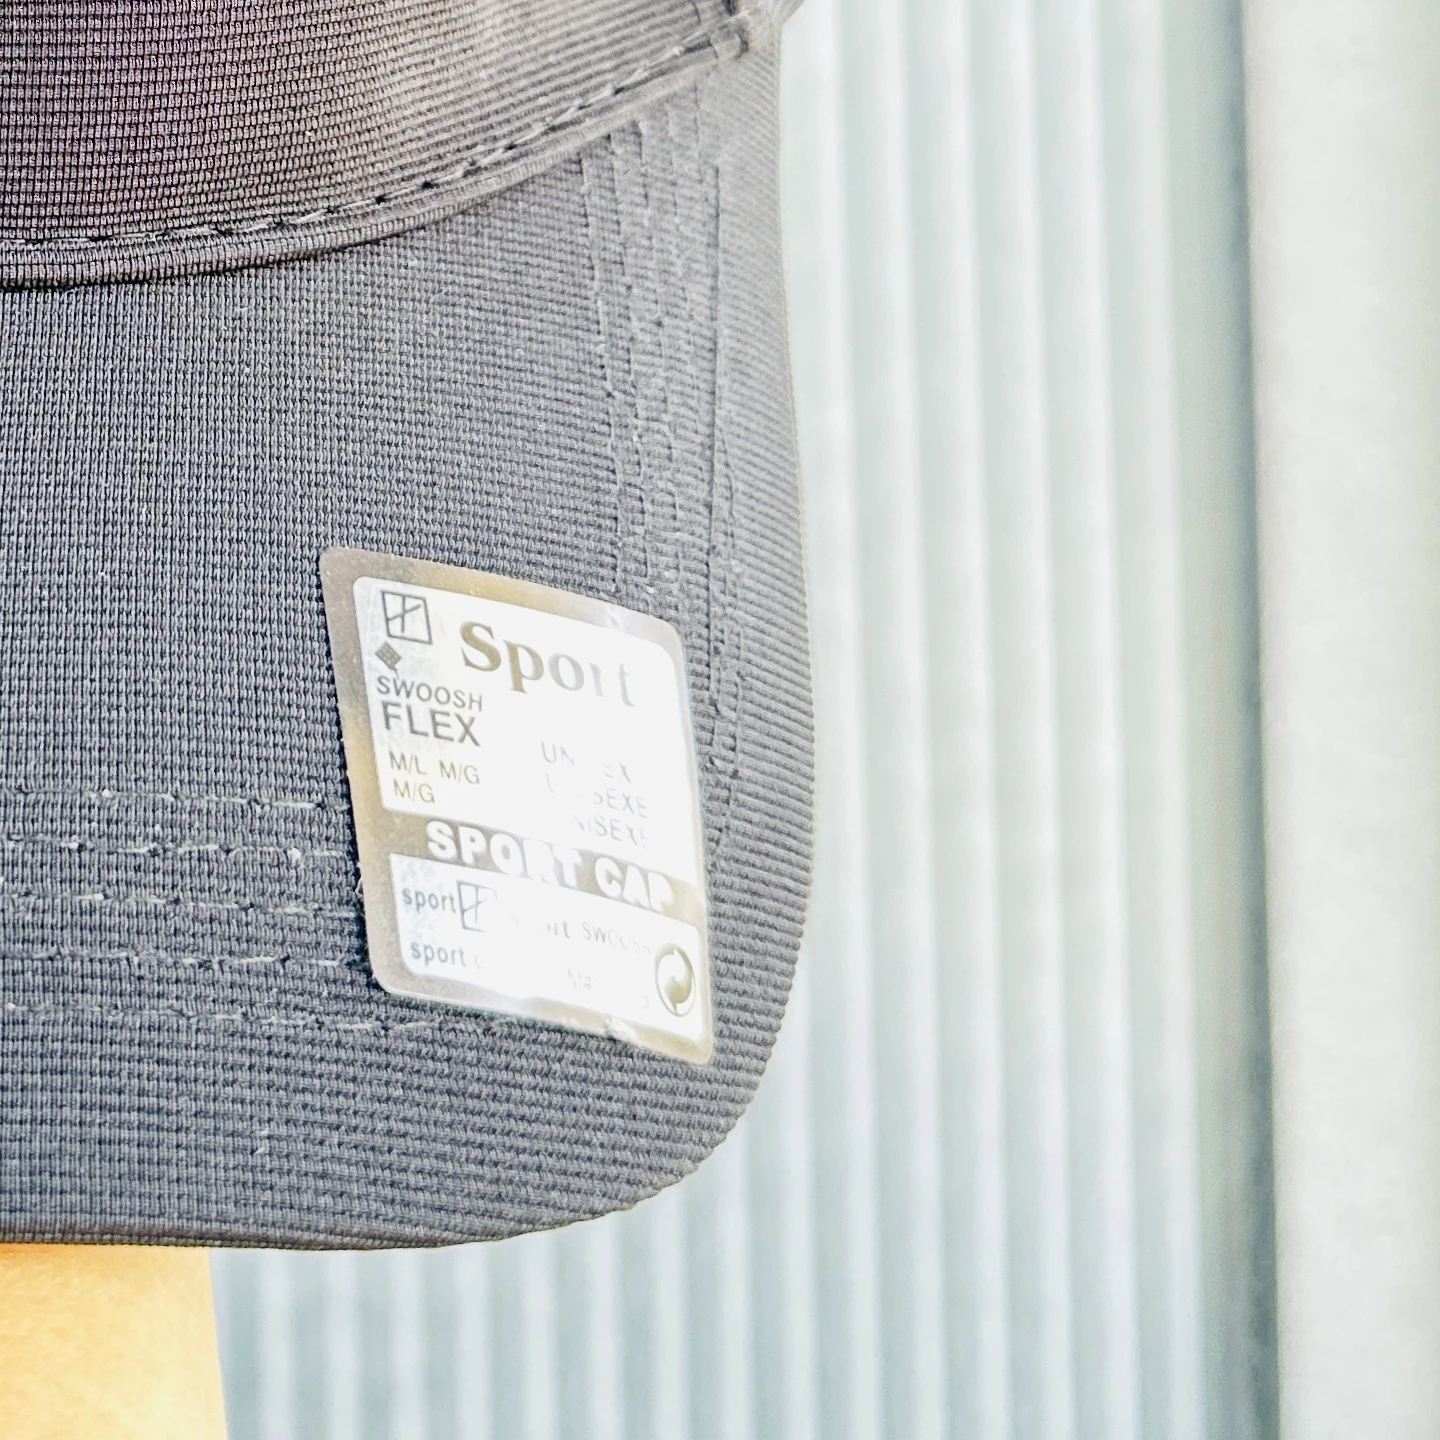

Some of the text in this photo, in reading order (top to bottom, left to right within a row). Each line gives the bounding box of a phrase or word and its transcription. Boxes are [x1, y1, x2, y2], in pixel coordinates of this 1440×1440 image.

[459, 620, 635, 707] Sport
[376, 675, 483, 713] SWOOSH
[381, 701, 481, 747] FLEX
[389, 751, 481, 785] M/L M/G
[541, 740, 632, 784] UNEX
[393, 779, 436, 804] M/G
[426, 821, 674, 914] SPORT CAP
[401, 887, 457, 917] sport
[410, 939, 467, 966] sport
